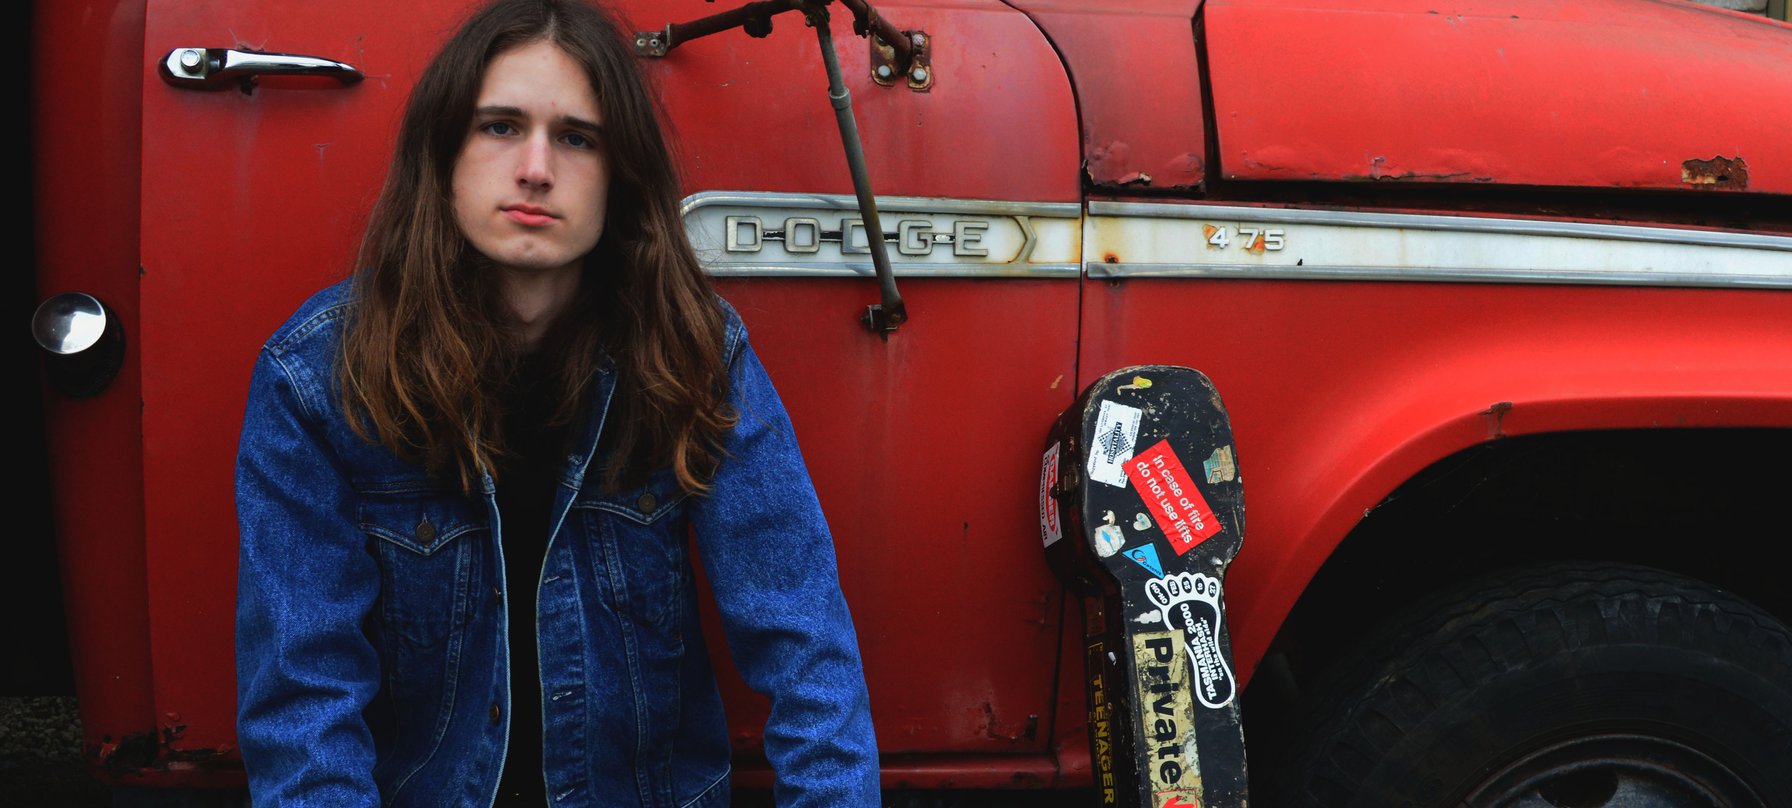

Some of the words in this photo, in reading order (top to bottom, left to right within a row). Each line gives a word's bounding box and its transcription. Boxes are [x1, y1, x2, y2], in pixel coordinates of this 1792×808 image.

[725, 215, 989, 257] DODGE
[1107, 422, 1122, 463] HOSPITALITY
[1137, 462, 1151, 478] do
[1147, 477, 1164, 499] not
[1161, 497, 1177, 520] use
[1175, 519, 1192, 544] lifts
[1161, 467, 1183, 497] case
[1180, 497, 1194, 512] of
[1188, 510, 1204, 531] fire
[1180, 603, 1196, 634] 2000
[1191, 636, 1217, 700] TASMANIA
[1195, 622, 1218, 680] INTERHASH
[1091, 674, 1115, 805] TEENAGER
[1145, 638, 1182, 785] Private
